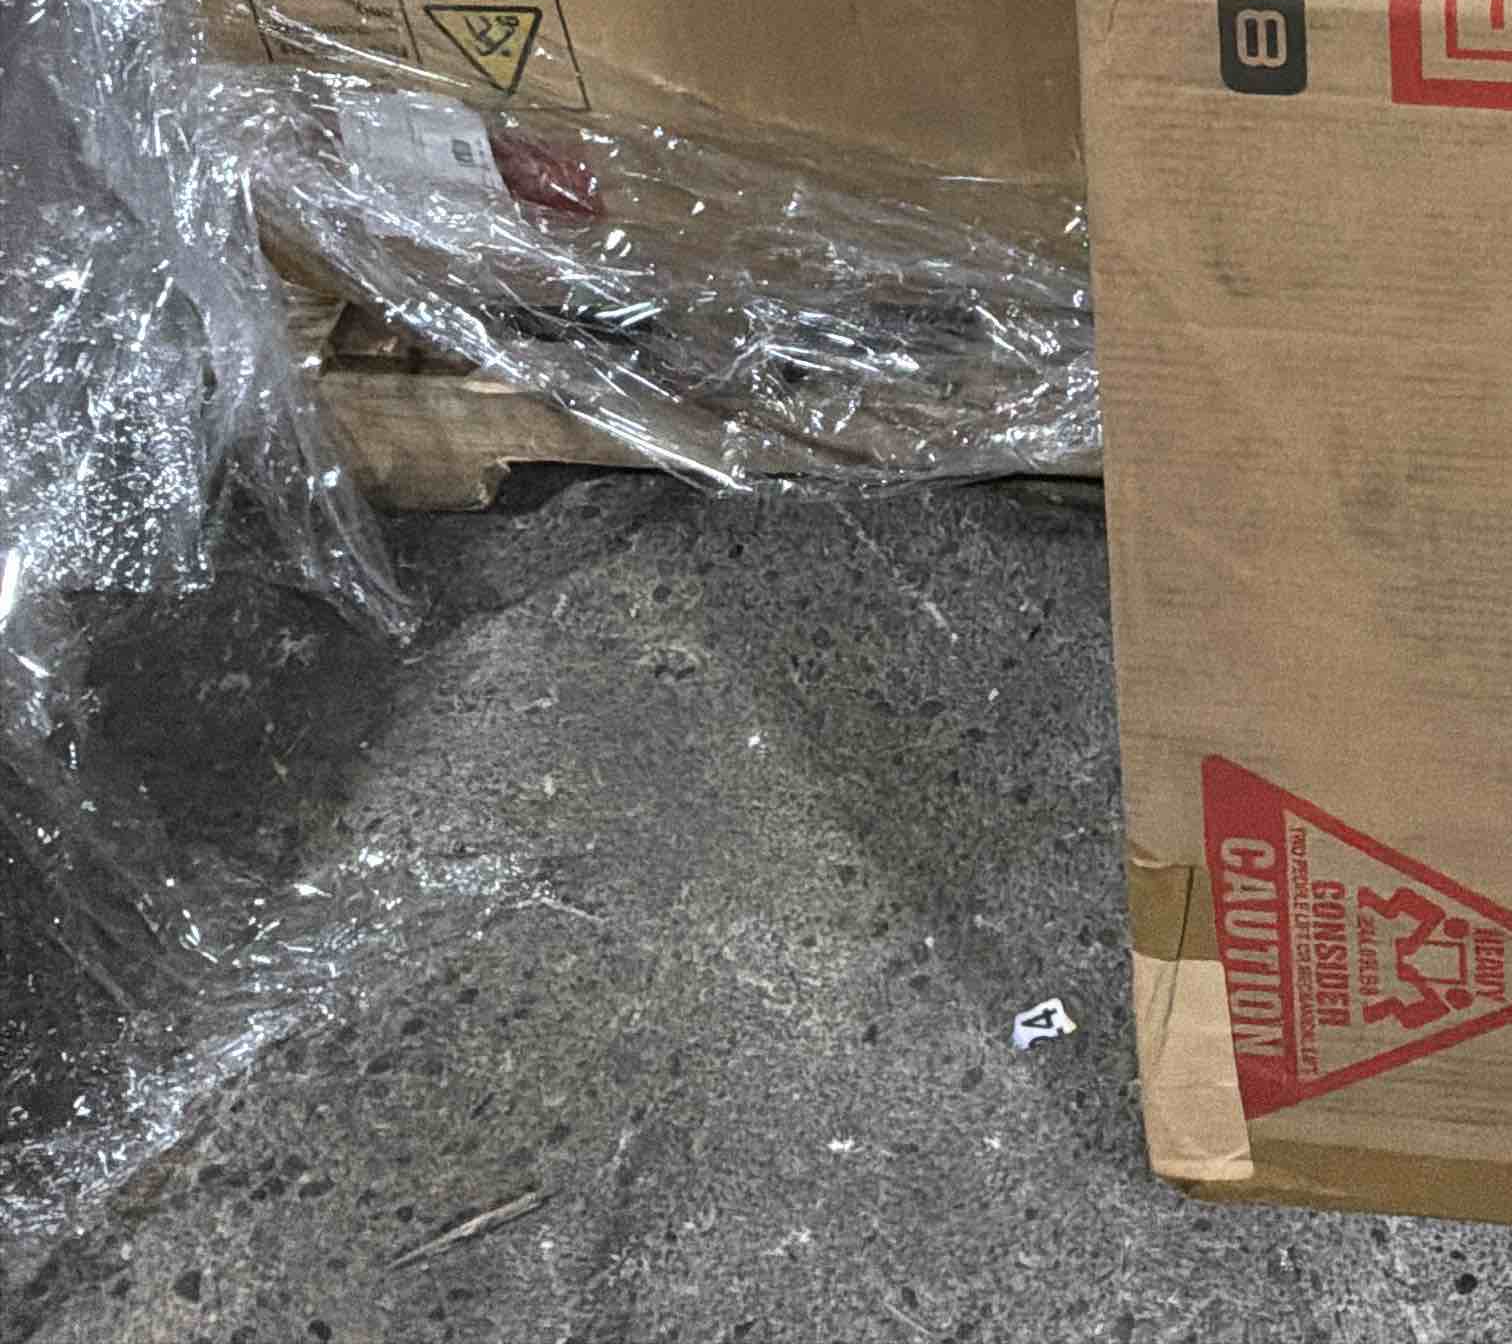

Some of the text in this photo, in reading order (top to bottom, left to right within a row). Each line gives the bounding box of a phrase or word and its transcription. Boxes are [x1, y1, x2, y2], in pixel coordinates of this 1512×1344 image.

[1289, 827, 1307, 856] TWO
[1220, 836, 1286, 1057] CAUTION
[1312, 879, 1351, 1027] CONSIDER
[1472, 926, 1505, 1002] HEAVY
